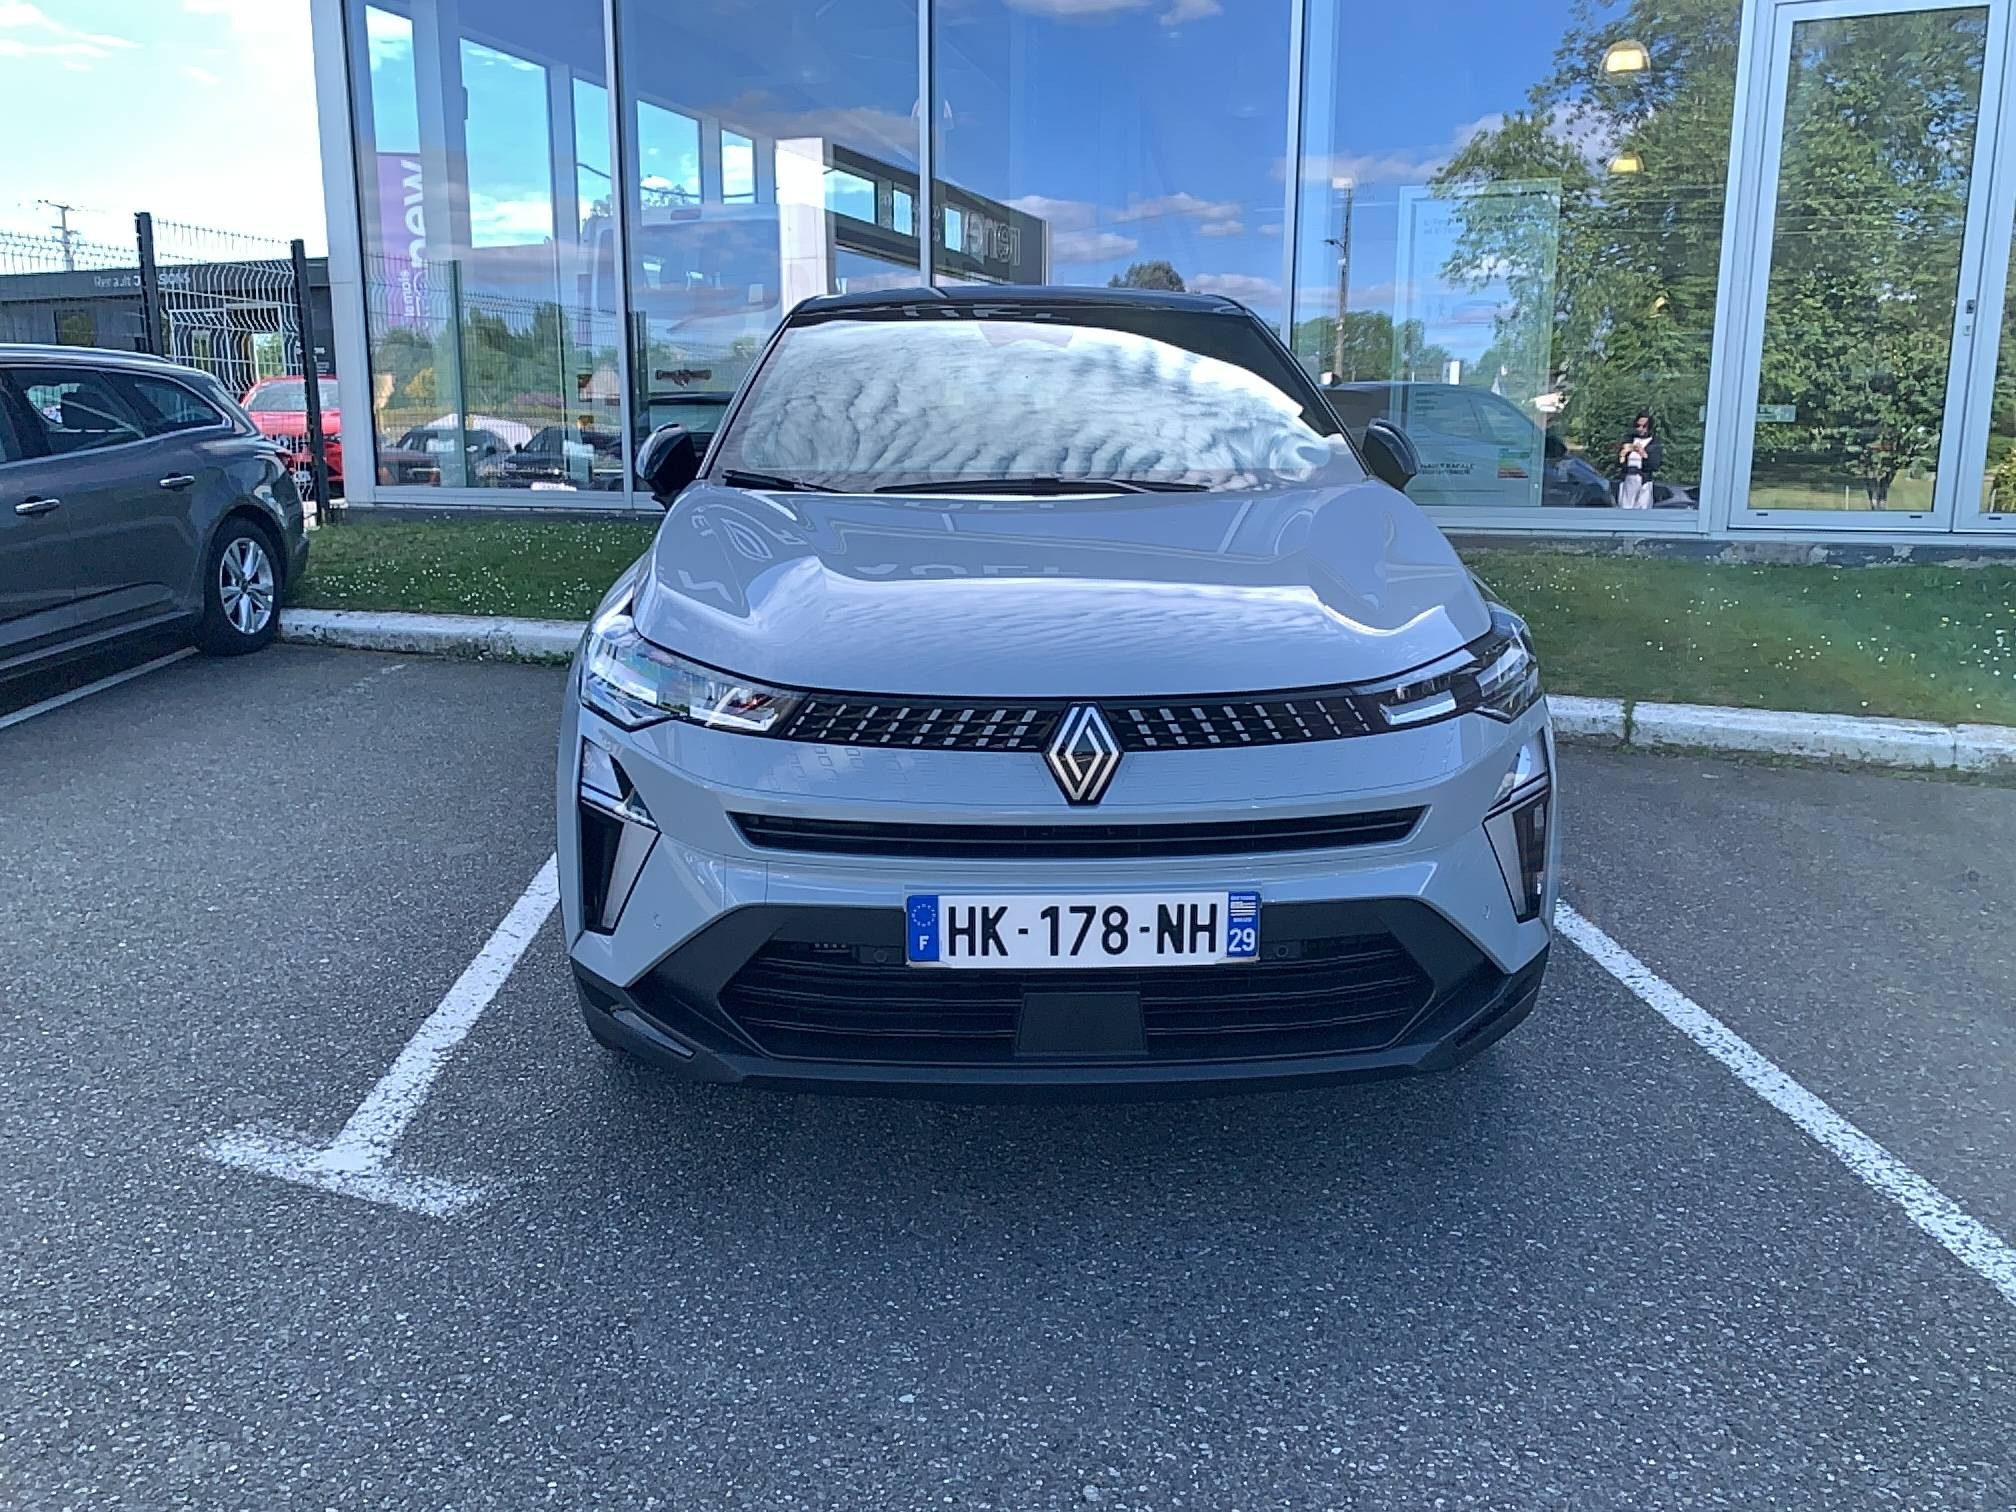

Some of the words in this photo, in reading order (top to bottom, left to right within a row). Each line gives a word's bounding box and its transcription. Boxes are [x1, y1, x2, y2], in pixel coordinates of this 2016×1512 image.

[918, 935, 930, 951] F
[947, 903, 1218, 957] HK-178-NH
[1229, 927, 1256, 953] 29
